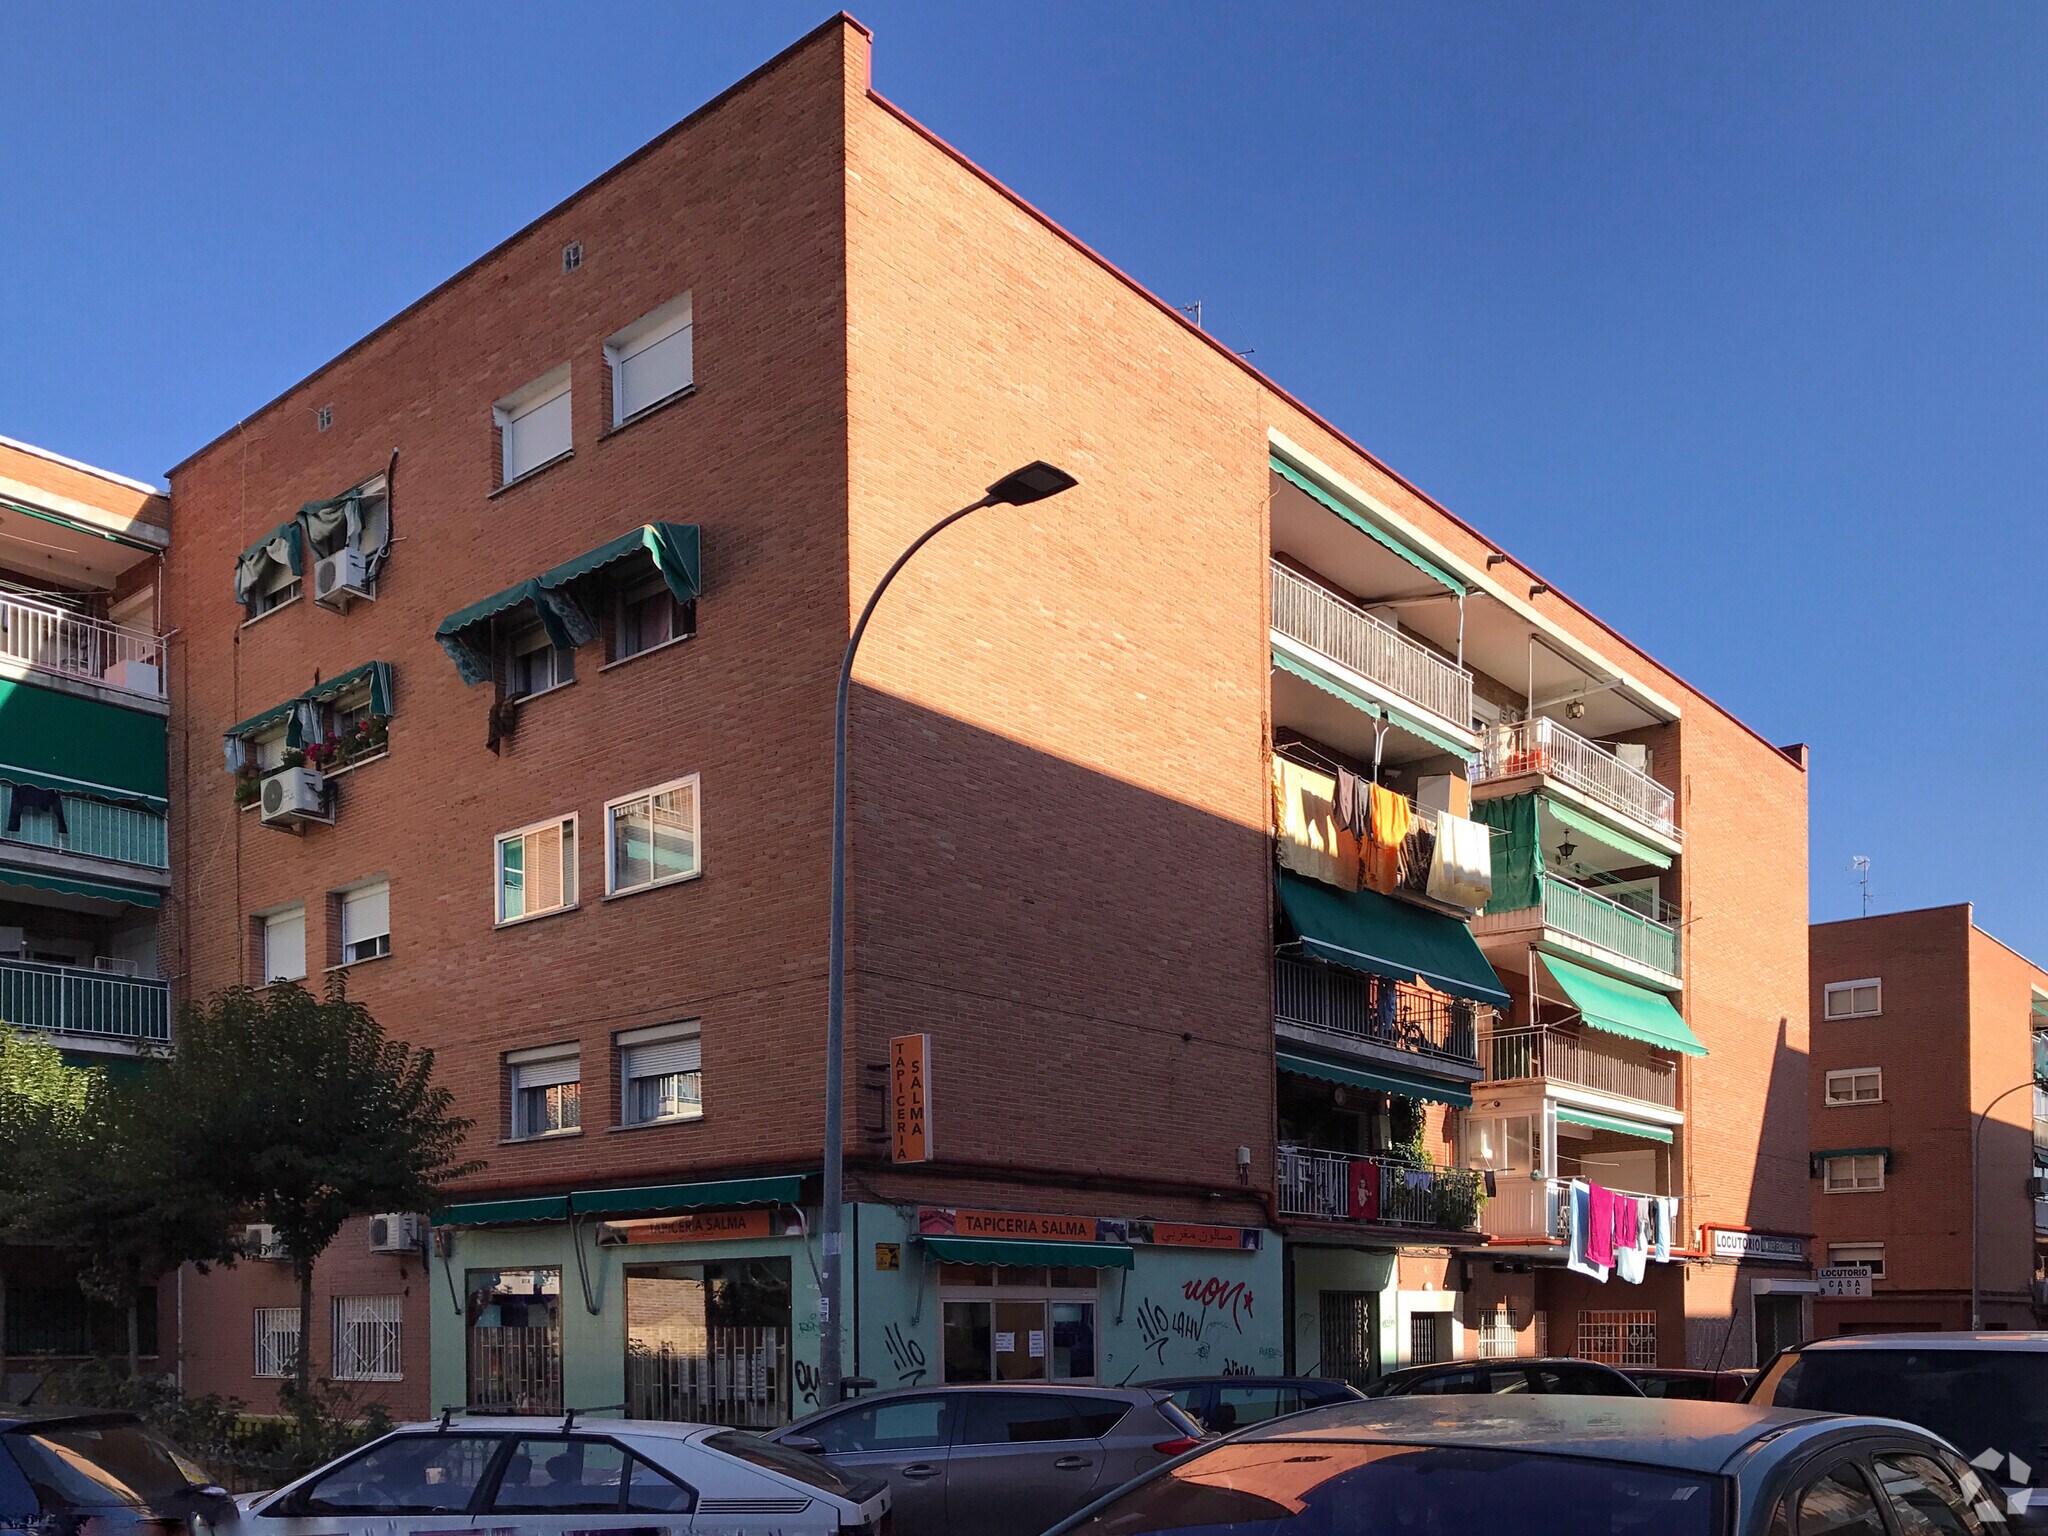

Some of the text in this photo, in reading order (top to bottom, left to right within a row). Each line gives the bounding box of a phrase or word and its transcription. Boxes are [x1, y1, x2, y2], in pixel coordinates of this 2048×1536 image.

[895, 1043, 907, 1159] TAPICERIA
[910, 1060, 923, 1136] SALMA
[706, 1216, 746, 1231] SALMA
[965, 1215, 1087, 1236] TAPICERIA SALMA
[1198, 1228, 1233, 1242] صالون
[1716, 1234, 1760, 1252] LOCUTORIO
[1821, 1269, 1868, 1277] LOCUTORIO
